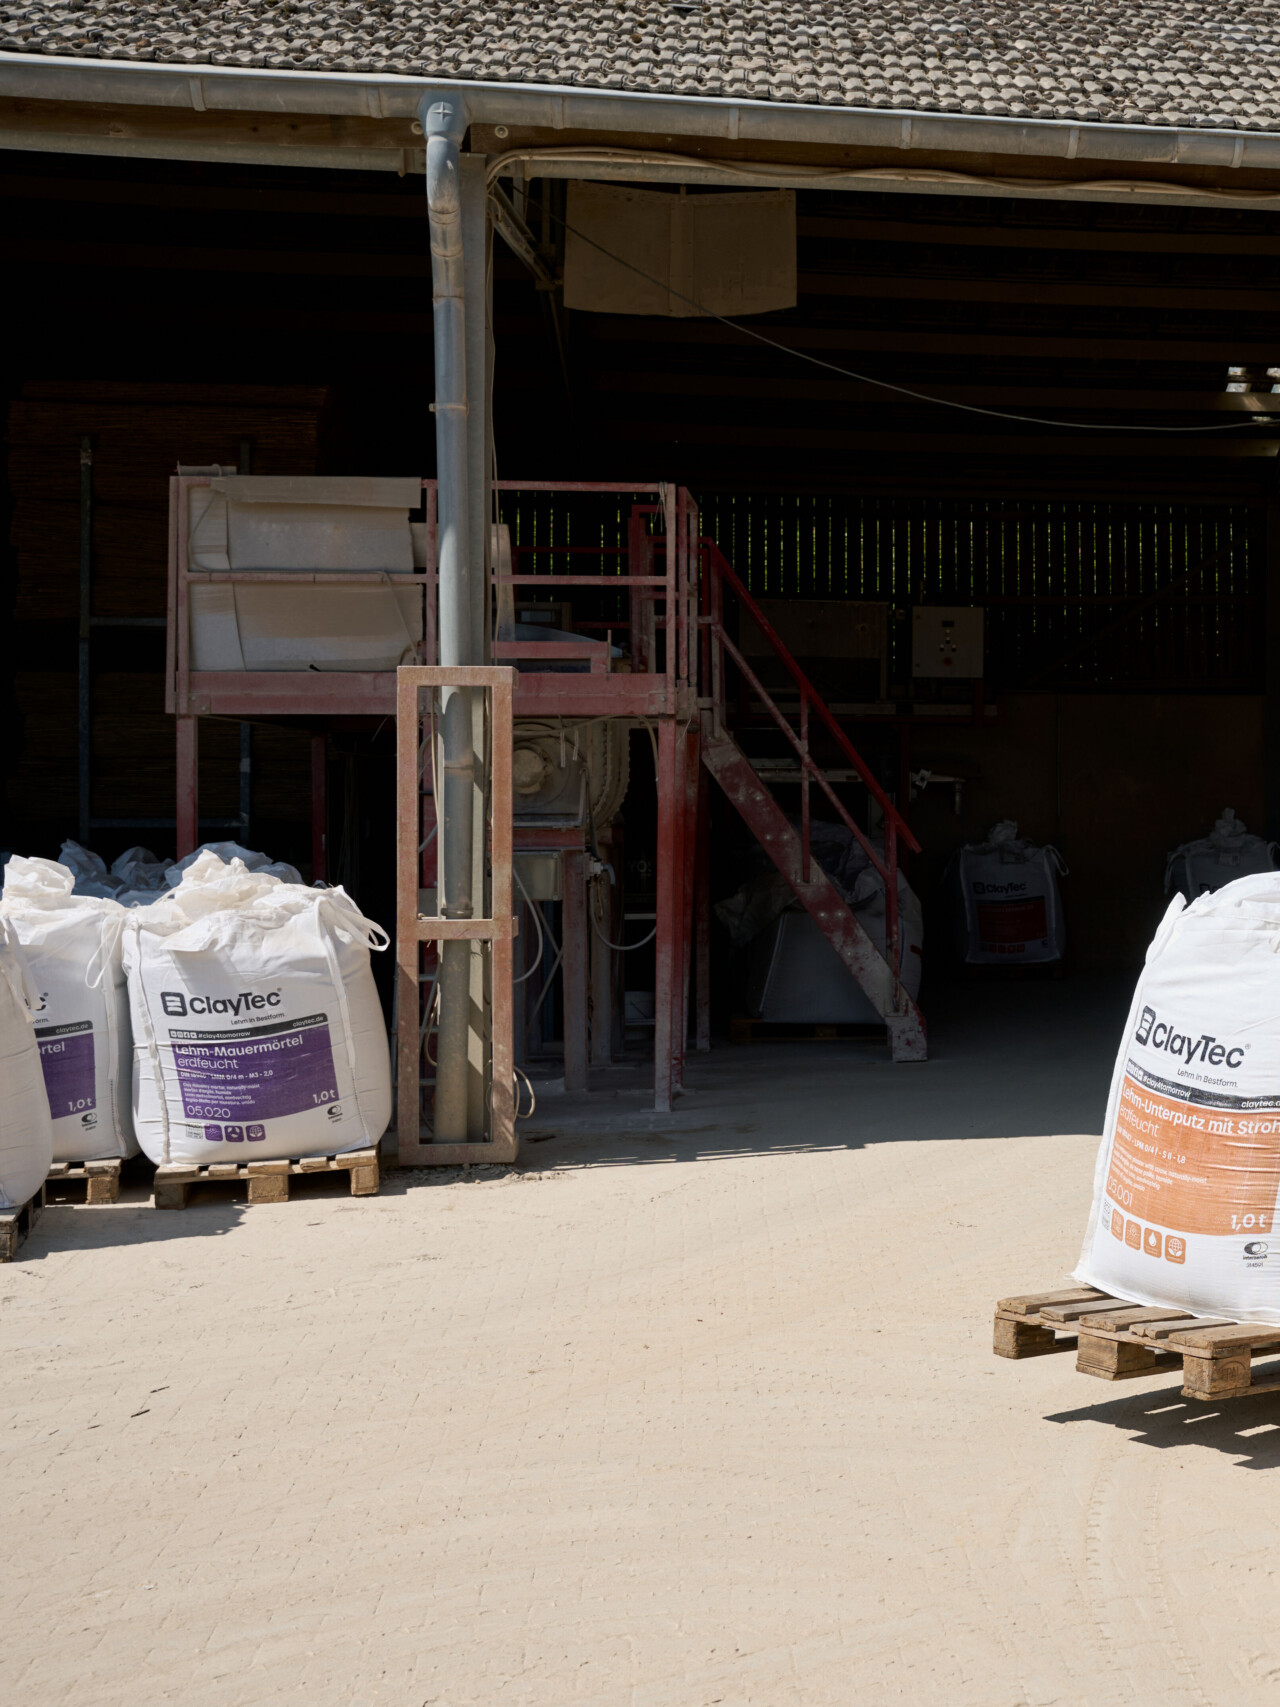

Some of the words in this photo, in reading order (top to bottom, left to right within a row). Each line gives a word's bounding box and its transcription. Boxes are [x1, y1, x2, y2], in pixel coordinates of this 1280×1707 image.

[986, 881, 1027, 895] ClayTec
[190, 992, 282, 1017] ClayTec
[56, 1023, 89, 1034] claytec.de
[231, 1018, 248, 1026] Lehm
[293, 1015, 325, 1028] claytec.de
[199, 1030, 251, 1040] #clay4tomorrow
[176, 1034, 304, 1057] Lehm-Mauermörtel
[1152, 1022, 1245, 1068] ClayTec
[178, 1057, 239, 1069] erdfeucht
[1177, 1067, 1195, 1080] Lehm
[1195, 1072, 1202, 1081] in
[1202, 1075, 1238, 1088] Bestform.
[1142, 1074, 1191, 1098] #clay4tomorrow
[313, 1090, 329, 1104] 1,0
[68, 1098, 85, 1112] 1,0
[187, 1105, 231, 1118] 05.020
[1122, 1083, 1205, 1129] Lehm-Unterputz
[1208, 1117, 1234, 1135] mit
[1119, 1104, 1160, 1138] erdfeucht
[1230, 1213, 1256, 1231] 1,0
[1259, 1213, 1267, 1227] t
